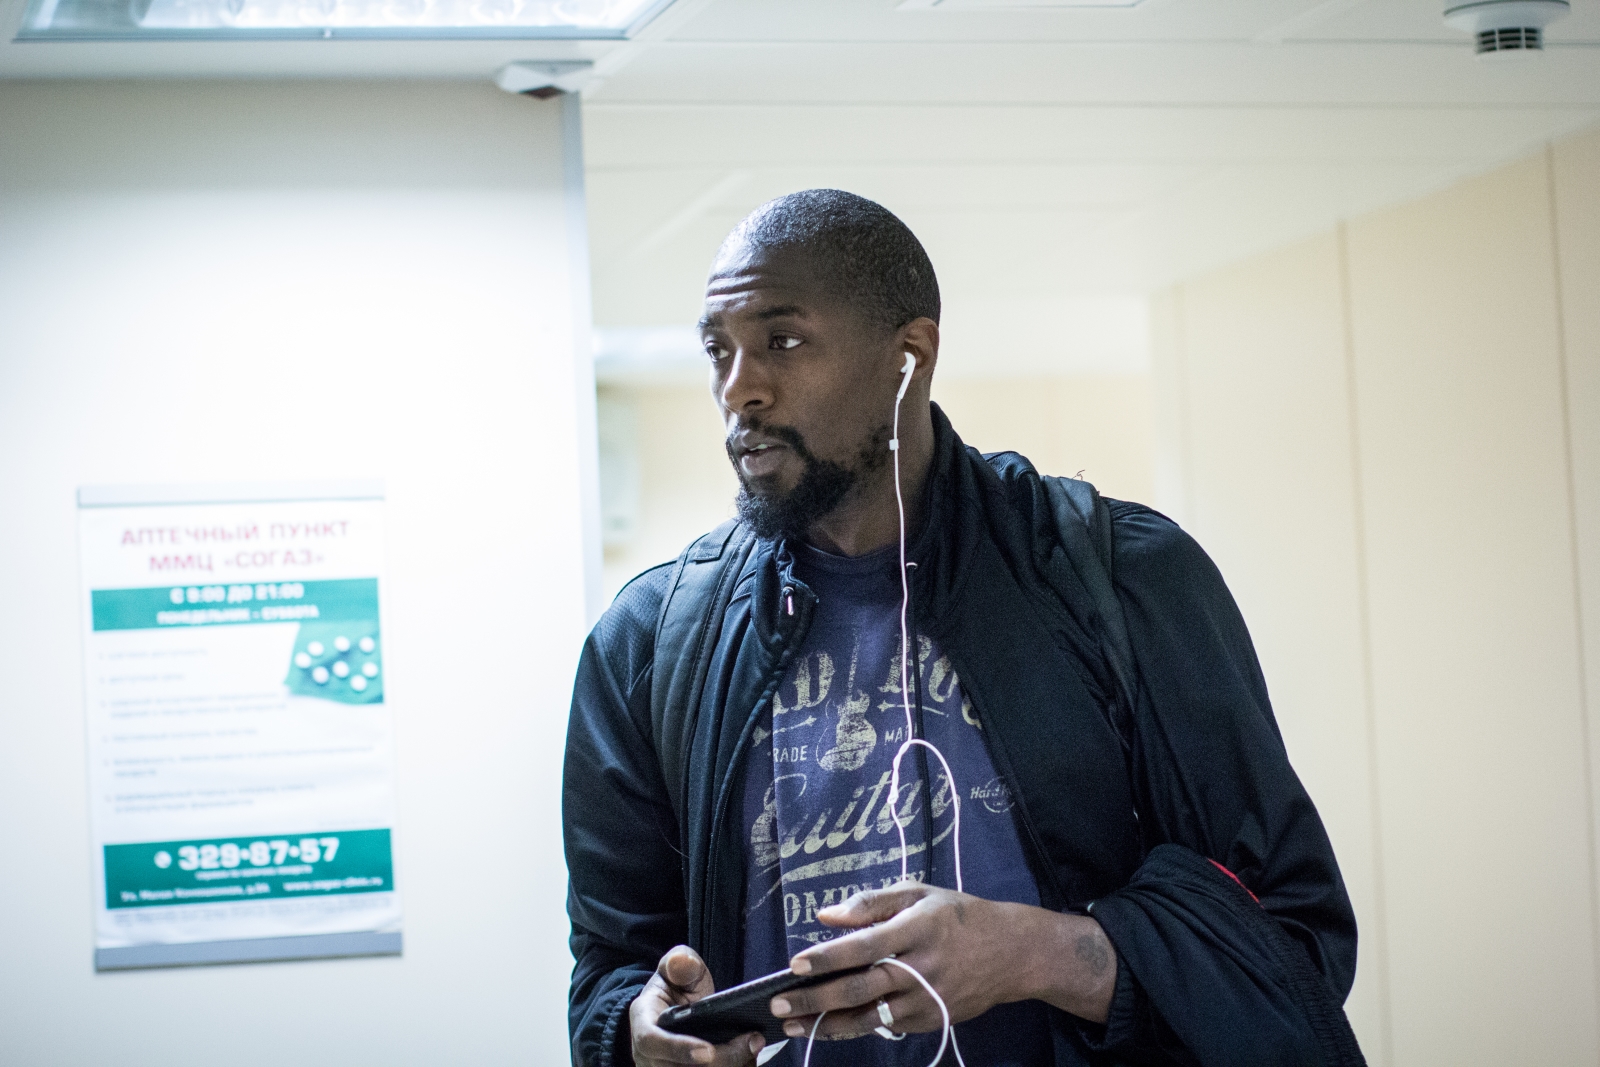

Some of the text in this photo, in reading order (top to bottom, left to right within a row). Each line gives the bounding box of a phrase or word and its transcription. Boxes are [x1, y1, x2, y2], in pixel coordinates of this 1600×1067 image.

[121, 519, 350, 546] АПТЕЧНЫЙ ПУНКТ
[149, 552, 213, 573] ММЦ
